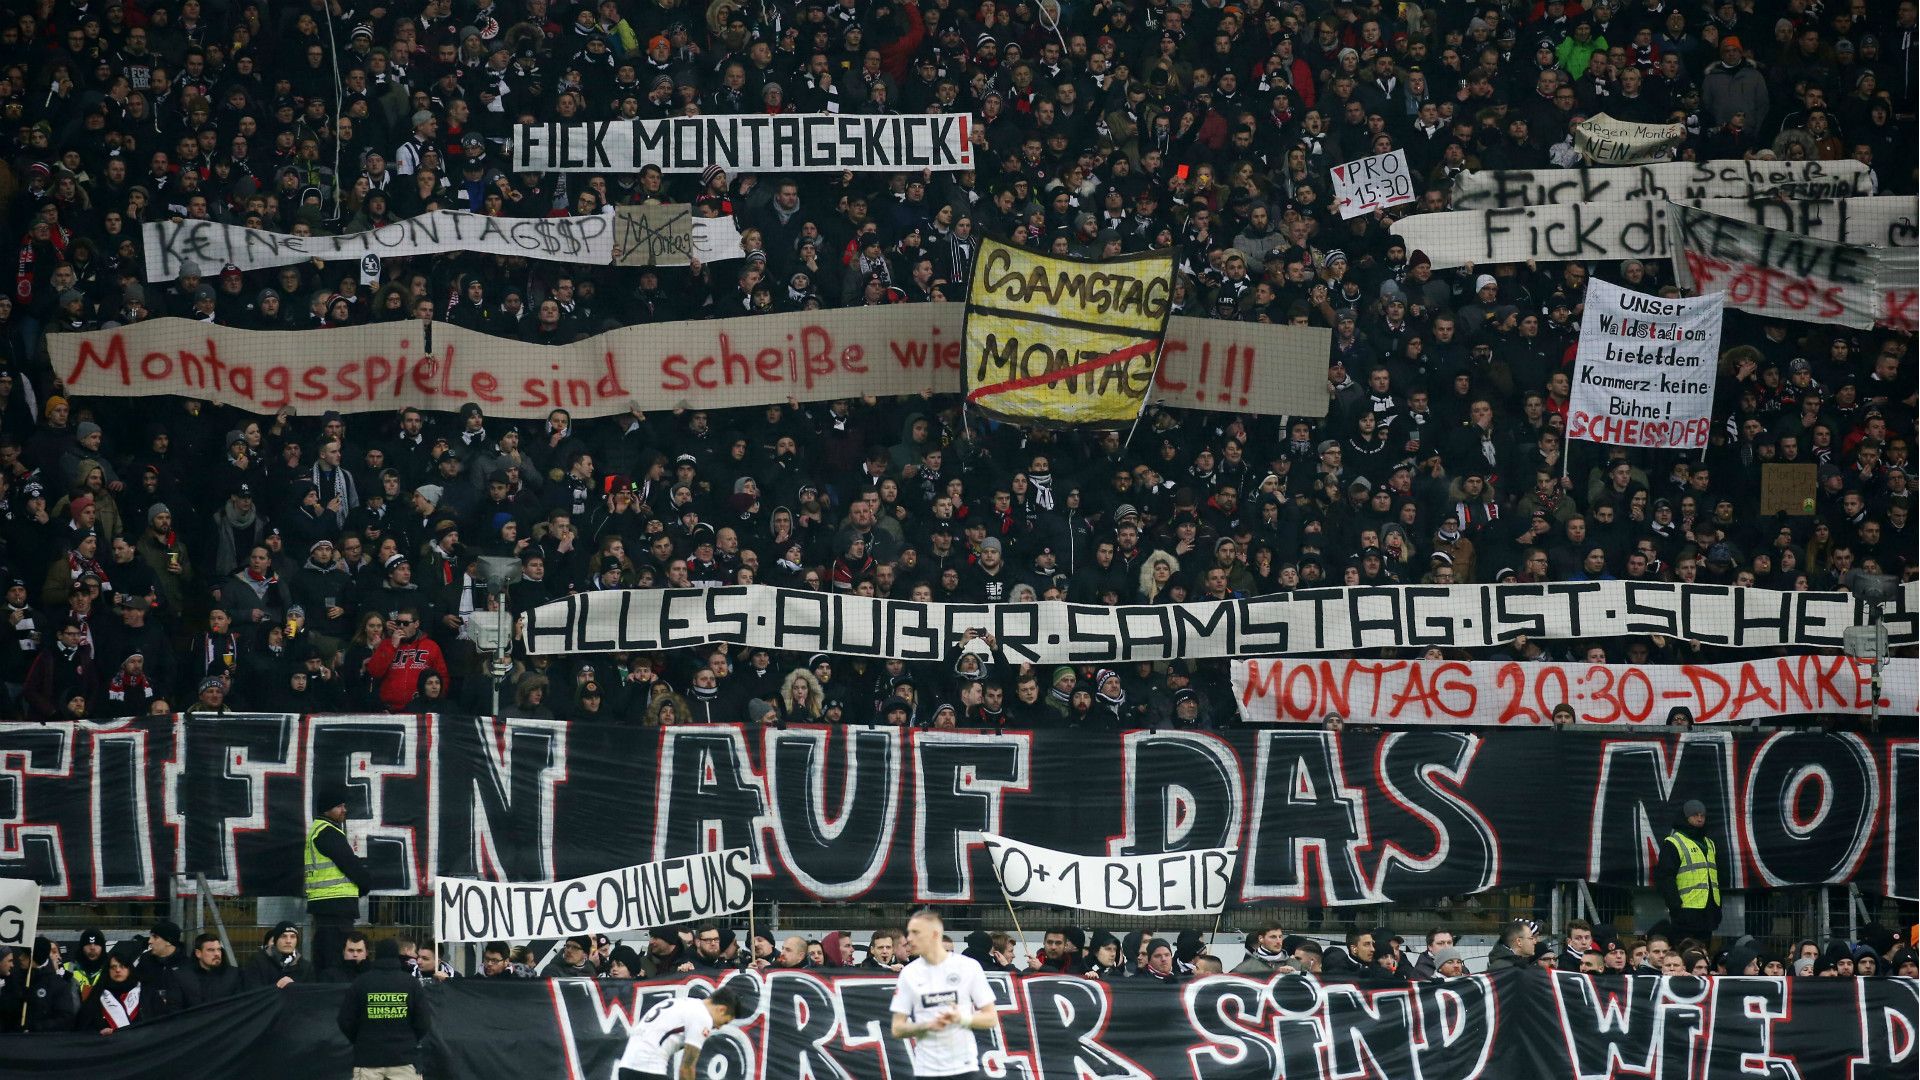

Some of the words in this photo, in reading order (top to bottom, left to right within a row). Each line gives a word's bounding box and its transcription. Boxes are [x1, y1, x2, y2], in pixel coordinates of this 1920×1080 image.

[521, 121, 609, 168] FICK
[632, 115, 970, 168] MONTAGSKICK!
[1585, 137, 1631, 160] NEIN
[1355, 174, 1409, 204] 15:30
[1486, 203, 1607, 258] Fick
[1681, 206, 1870, 284] KEINE
[984, 248, 1169, 319] SAMSTAG
[518, 351, 630, 408] sind
[661, 325, 868, 390] scheiße
[890, 325, 961, 372] wie
[977, 333, 1153, 398] MONTAG
[1580, 365, 1650, 392] Kommerz
[1660, 373, 1708, 394] keine
[1242, 659, 1479, 720] MONTAG
[651, 724, 1032, 903] AUF
[1107, 728, 1500, 907] DAS
[441, 881, 595, 941] MONTAG
[596, 859, 692, 929] OHNE
[686, 850, 751, 915] UNS
[367, 993, 409, 1002] PROTECT
[367, 1006, 408, 1015] EINSATZ
